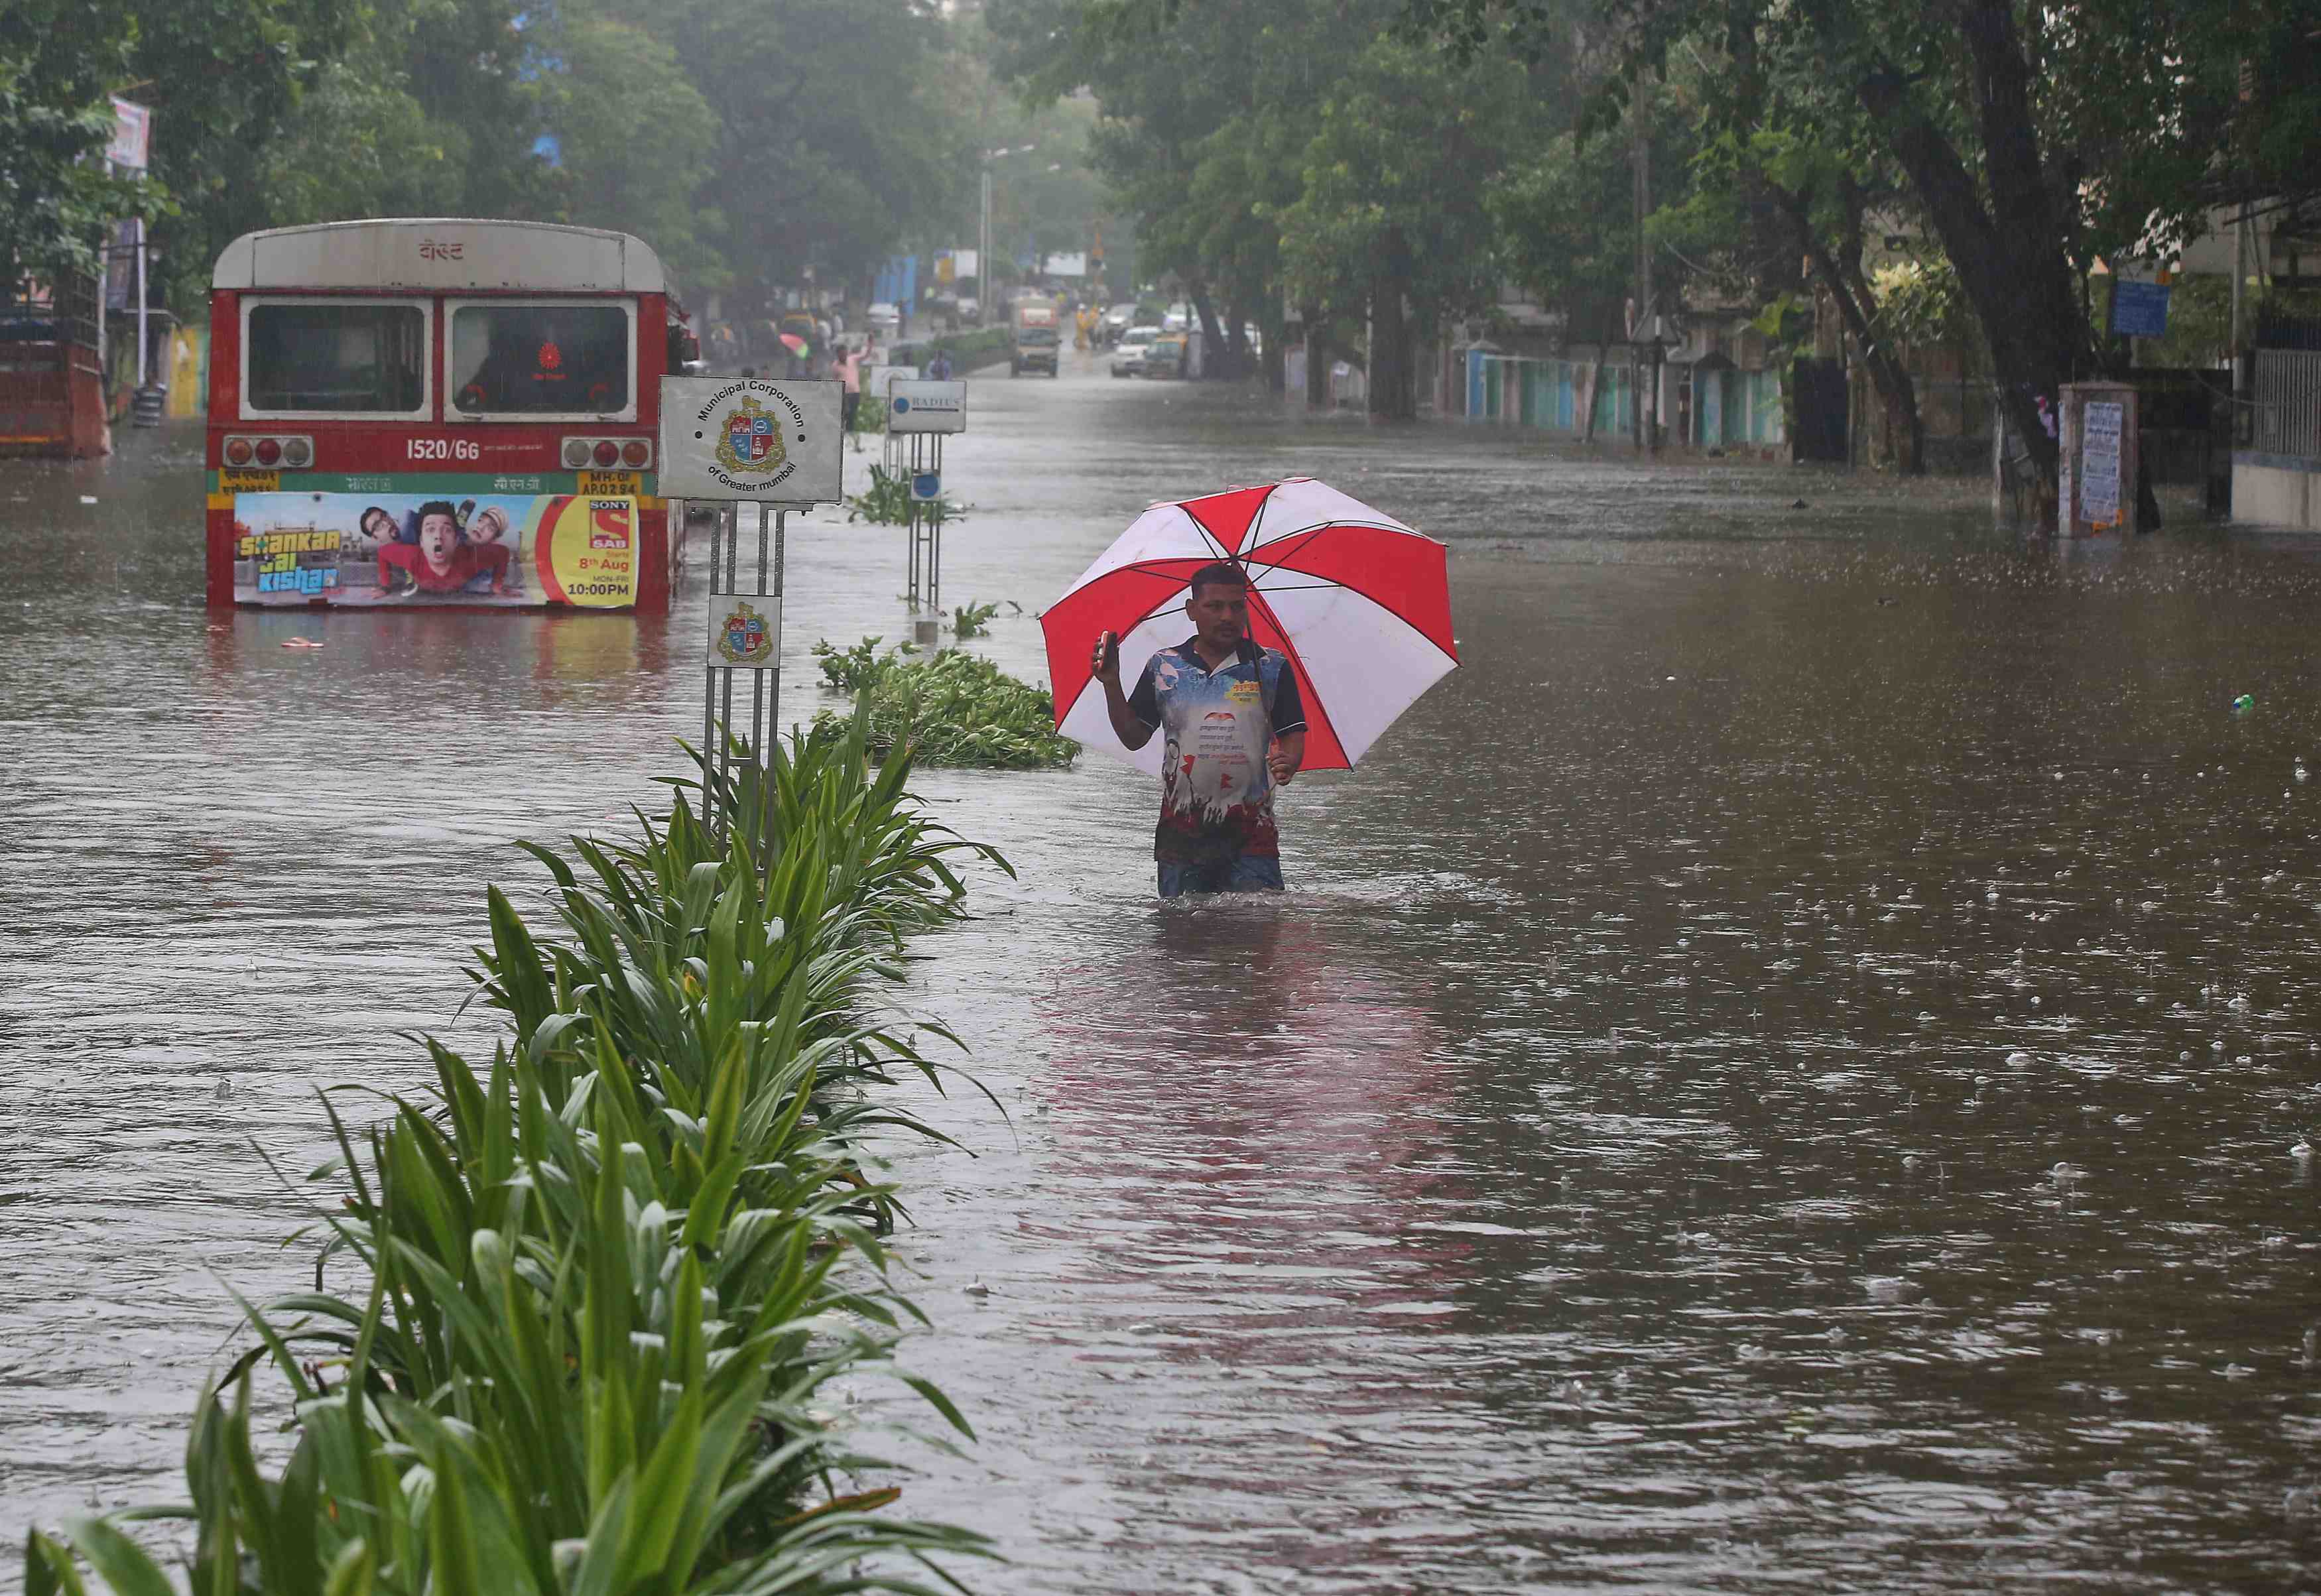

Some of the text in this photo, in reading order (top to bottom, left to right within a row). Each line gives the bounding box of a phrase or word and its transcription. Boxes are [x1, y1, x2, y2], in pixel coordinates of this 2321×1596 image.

[698, 380, 804, 428] Municipal Corporation
[708, 461, 796, 491] of Greater mumbai
[580, 558, 629, 572] 8th Aug
[568, 584, 629, 595] 10:00PM
